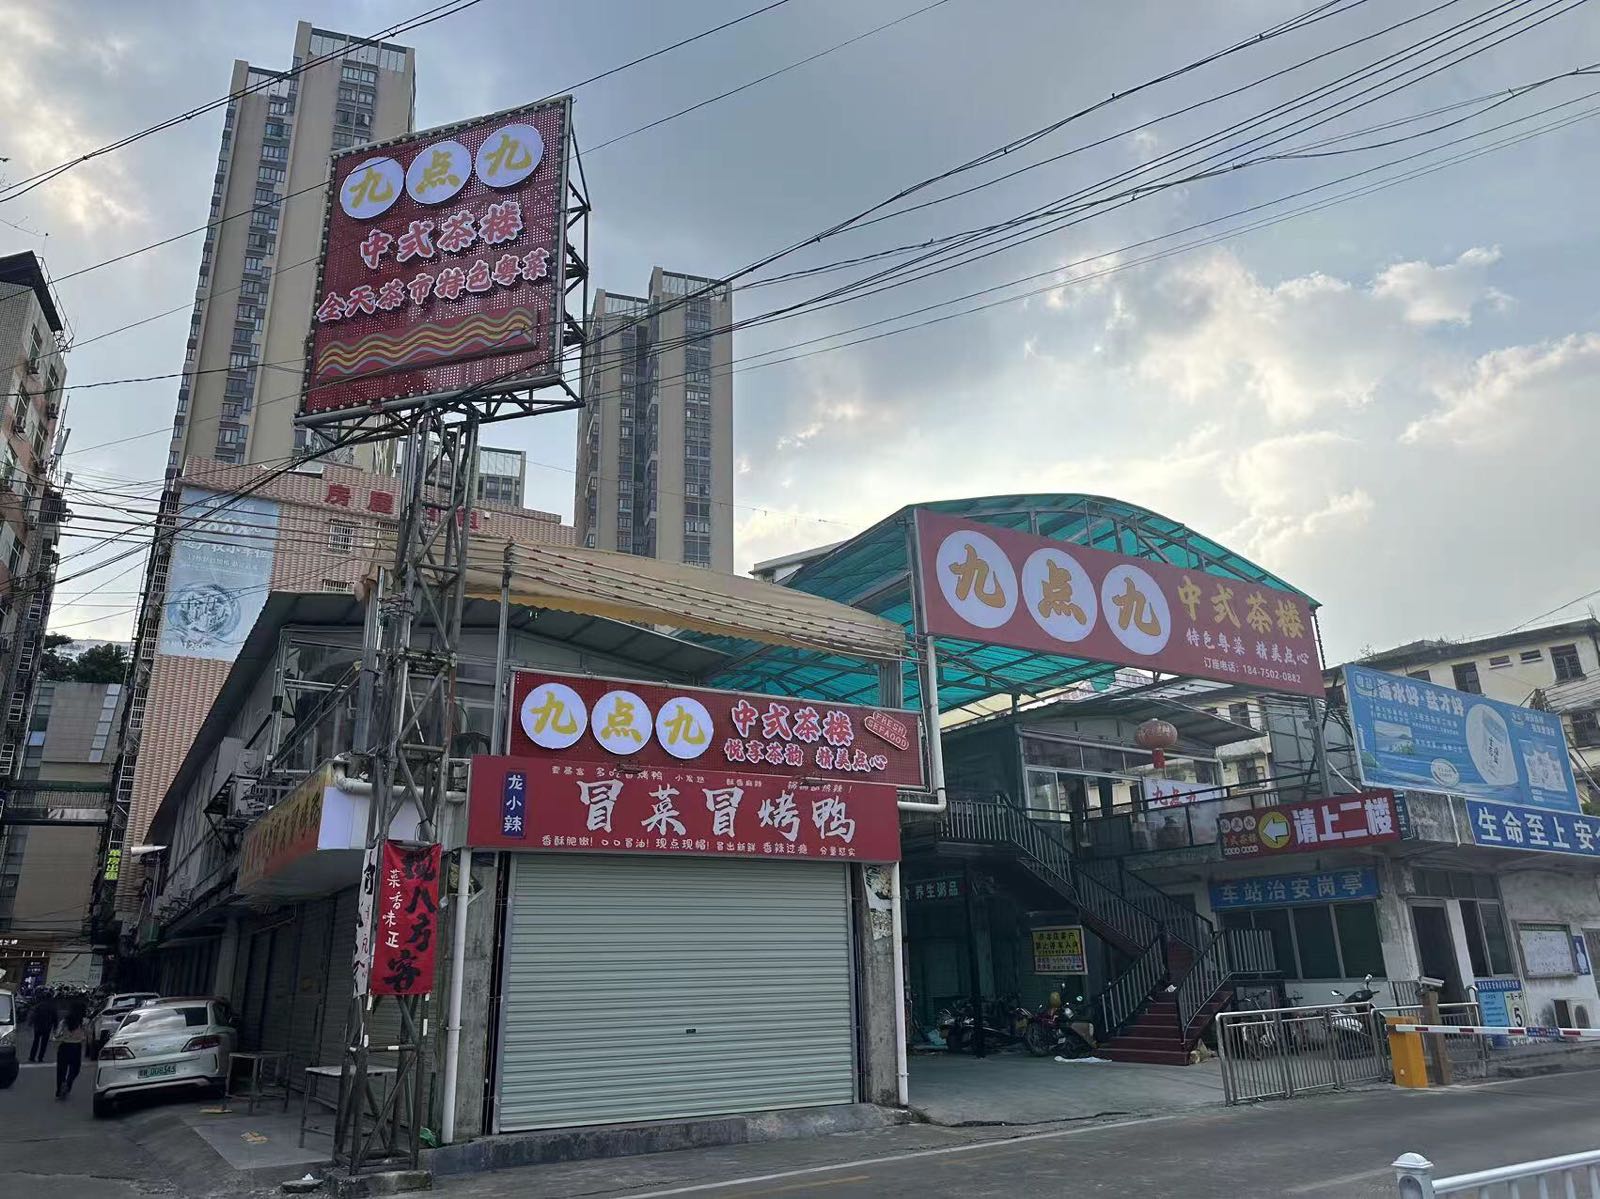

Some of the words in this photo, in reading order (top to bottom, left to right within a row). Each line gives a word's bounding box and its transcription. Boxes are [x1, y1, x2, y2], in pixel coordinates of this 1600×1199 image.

[345, 129, 538, 212] 九点九
[360, 201, 524, 269] 中式茶楼
[316, 248, 549, 322] 全天茶市特色粤菜
[944, 538, 1165, 644] 九点九
[1177, 575, 1305, 639] 中式茶楼
[1186, 627, 1246, 656] 特色粤菜
[1255, 640, 1310, 665] 精美点心
[525, 687, 710, 753] 九点九
[731, 699, 854, 747] 中式茶楼
[866, 720, 909, 749] SEFAOOD
[876, 712, 907, 734] FRESH
[724, 738, 803, 767] 悦享茶韵
[815, 746, 888, 772] 精美点心
[504, 774, 523, 832] 龙小辣
[576, 778, 856, 844] 冒菜冒烤鸭
[1291, 797, 1395, 845] 请上二楼
[1477, 806, 1600, 851] 生命至上安
[381, 868, 404, 949] 菜香味正
[1220, 870, 1363, 904] 车站治安岗亭
